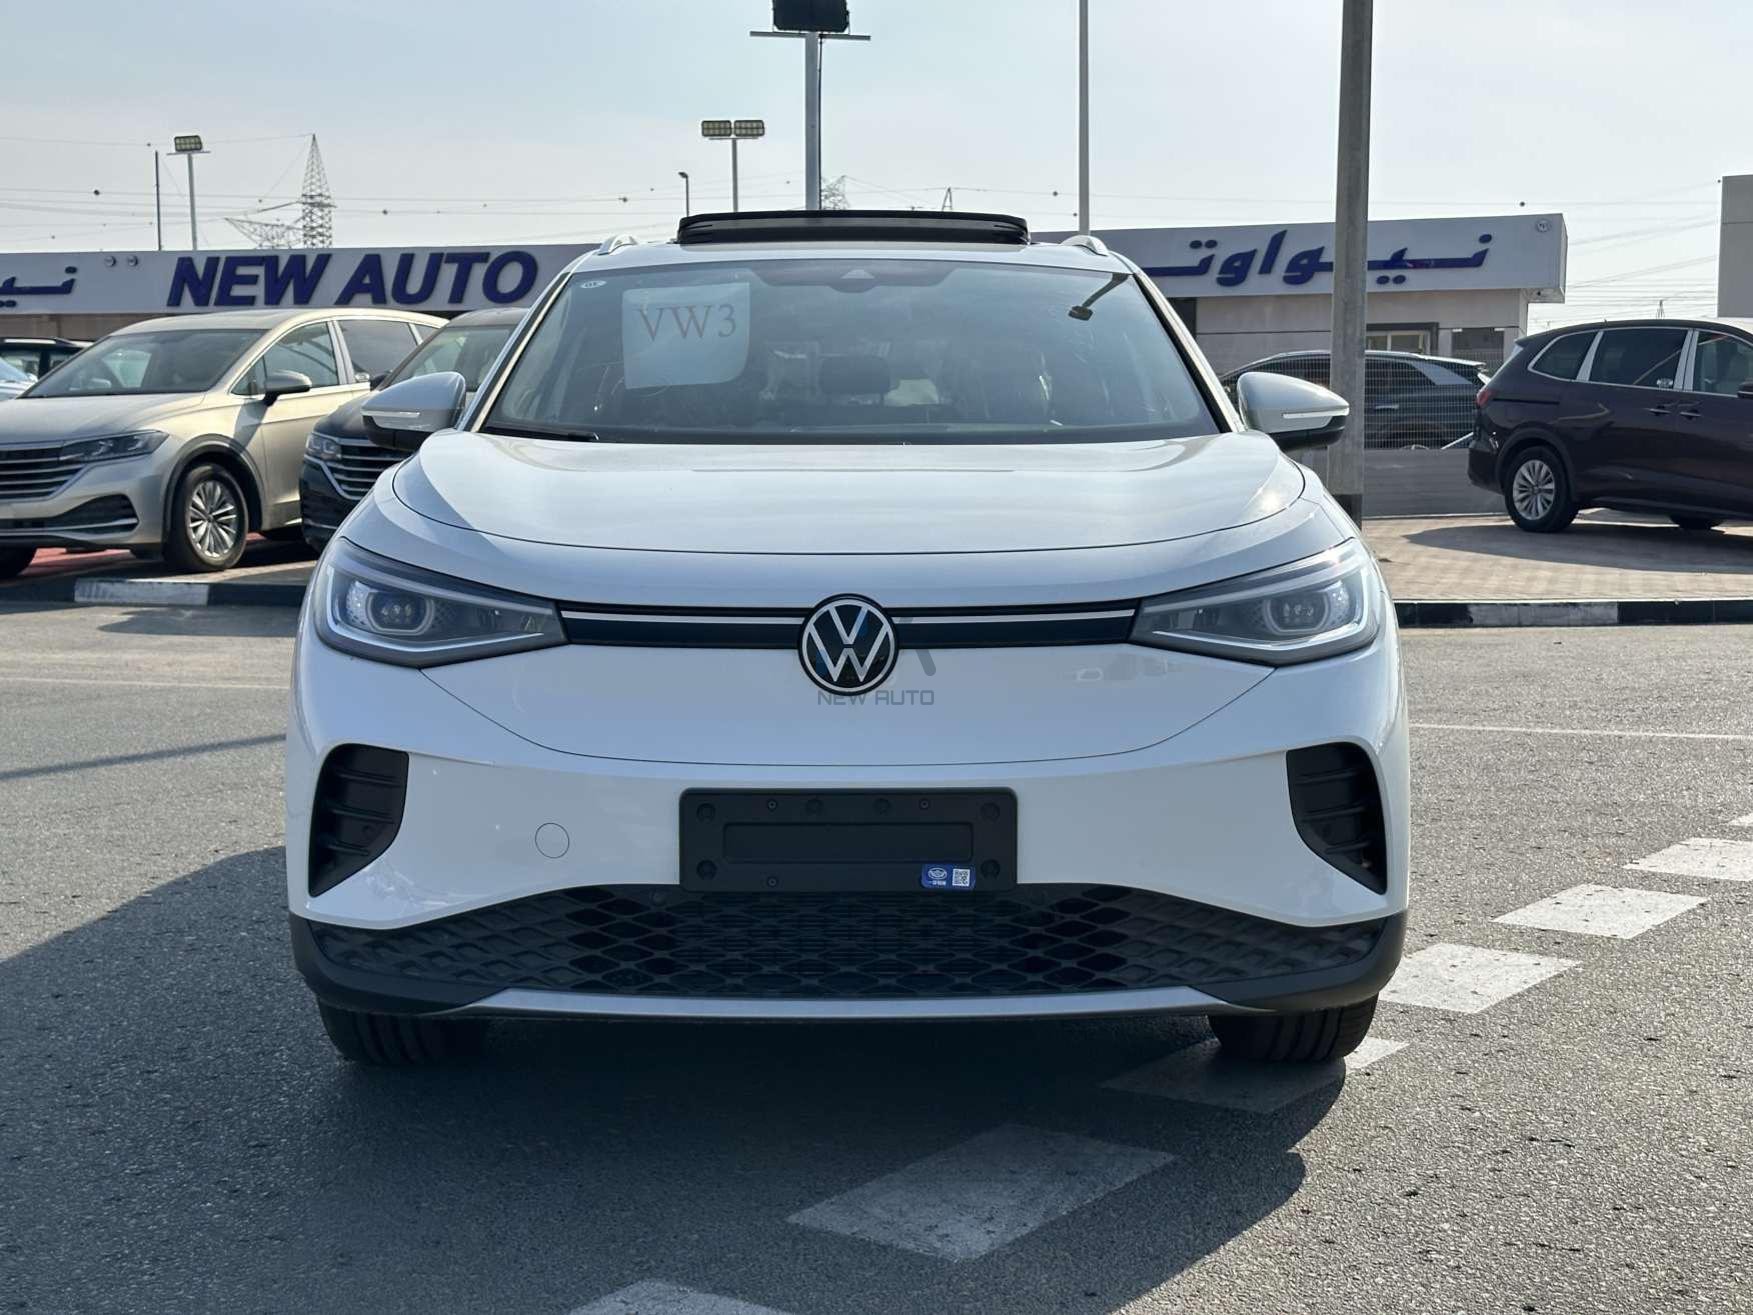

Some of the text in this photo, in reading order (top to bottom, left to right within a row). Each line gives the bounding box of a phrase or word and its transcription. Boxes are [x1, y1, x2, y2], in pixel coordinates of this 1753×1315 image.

[0, 266, 77, 308] ني
[167, 250, 539, 307] NEW AUTO
[636, 303, 737, 342] VW3
